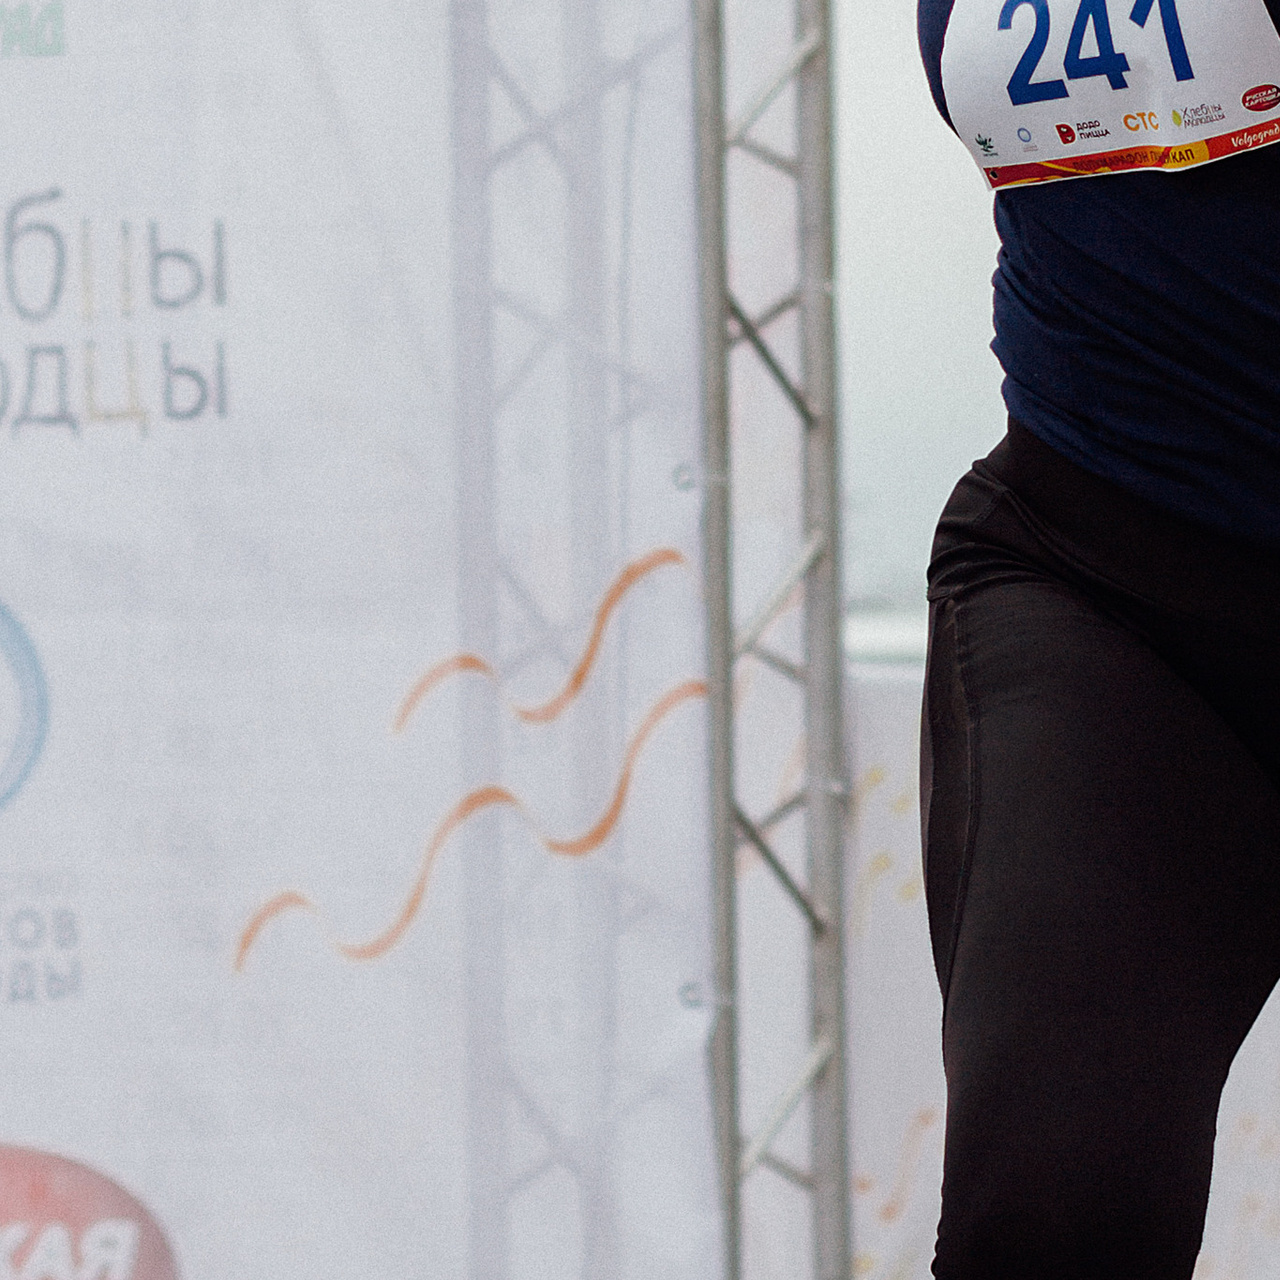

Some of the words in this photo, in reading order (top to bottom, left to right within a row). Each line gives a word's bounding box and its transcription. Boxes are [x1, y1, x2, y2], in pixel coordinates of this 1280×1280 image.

[1076, 120, 1101, 131] ДОДО
[1123, 111, 1159, 131] СТС
[1079, 129, 1111, 140] ПИЦЦА
[1231, 123, 1280, 147] Volgograd
[0, 336, 229, 439] дцы
